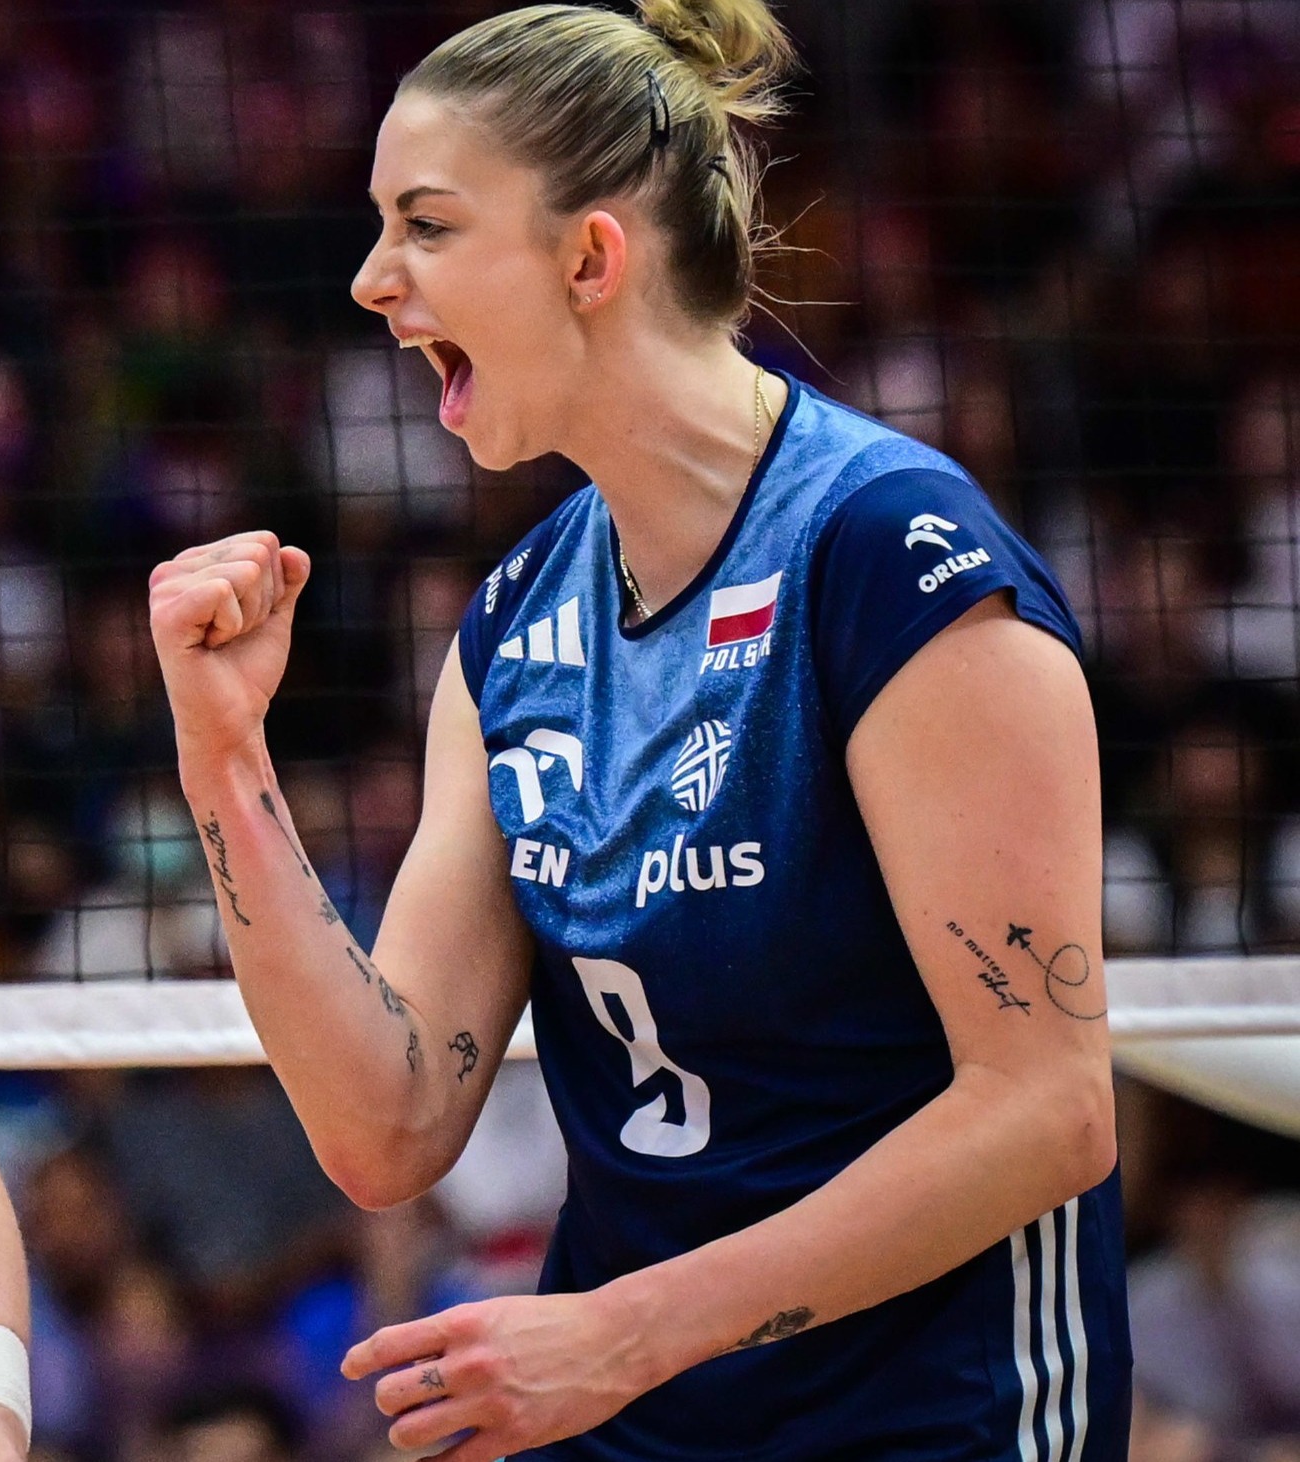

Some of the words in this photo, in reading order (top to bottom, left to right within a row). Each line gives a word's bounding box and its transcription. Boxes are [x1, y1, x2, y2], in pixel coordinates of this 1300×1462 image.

[918, 547, 991, 593] ORLEN
[700, 632, 771, 675] POLSA
[636, 834, 765, 908] plus
[946, 920, 964, 938] no
[965, 938, 1009, 980] matter
[977, 970, 1031, 1017] what
[571, 956, 711, 1158] 9
